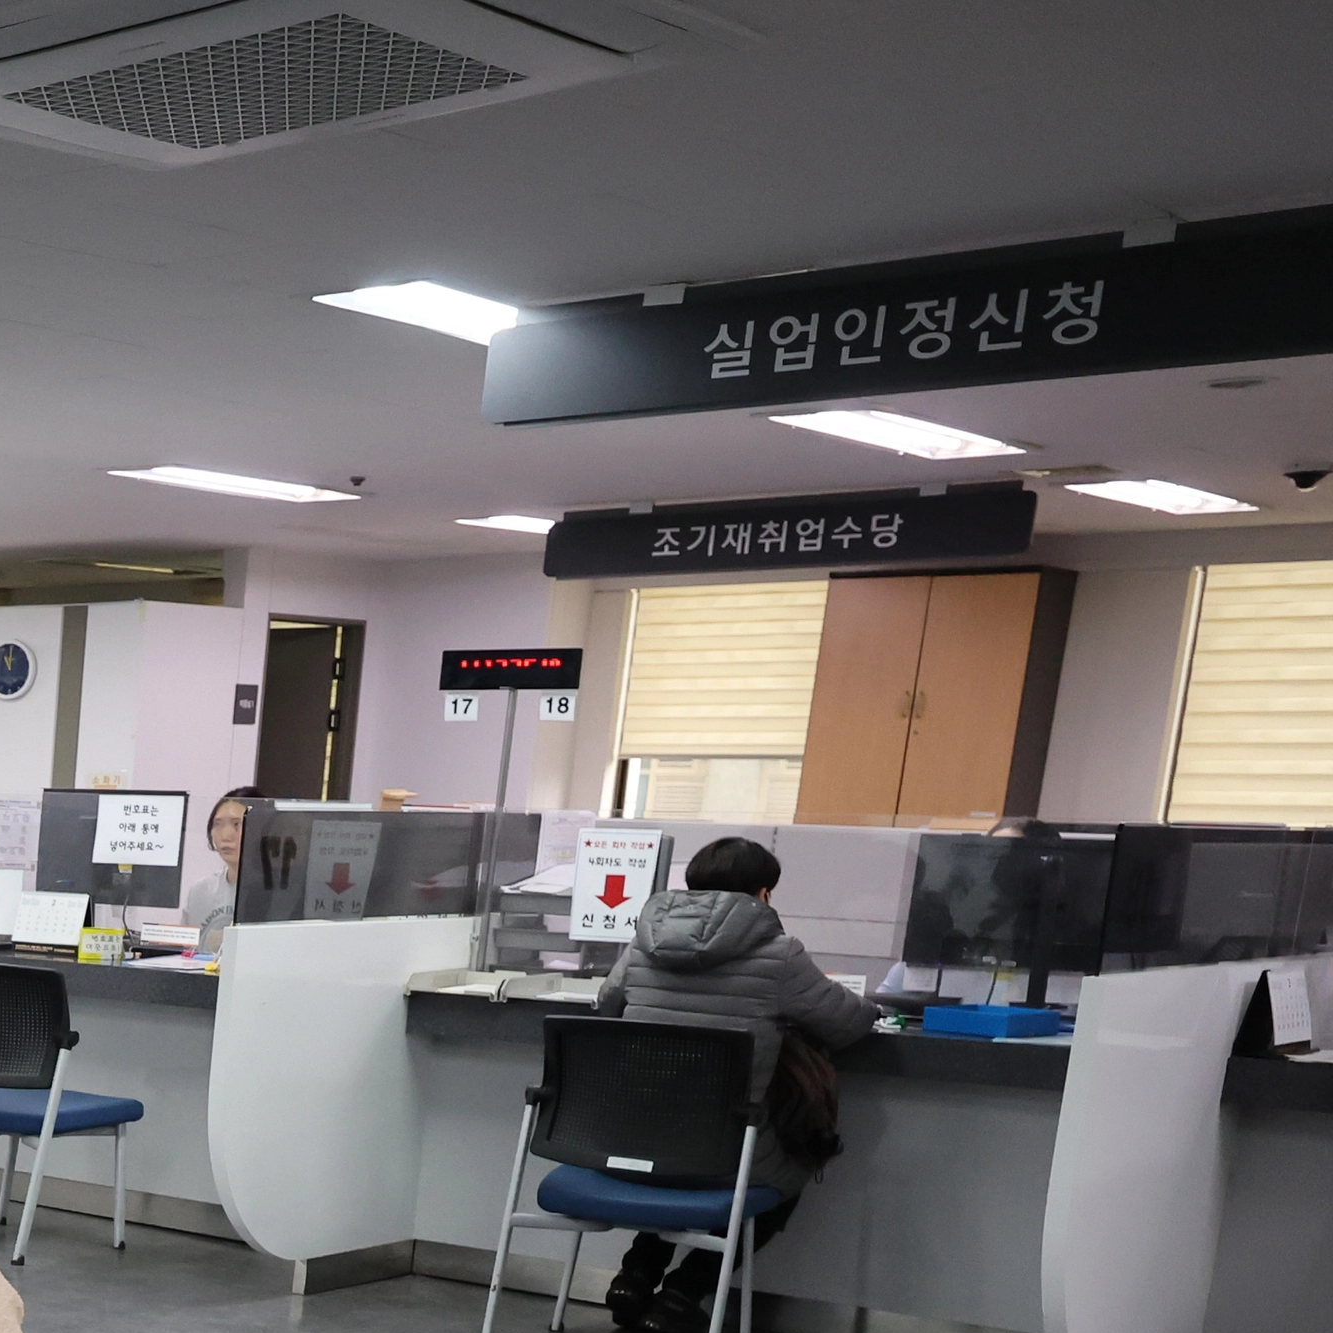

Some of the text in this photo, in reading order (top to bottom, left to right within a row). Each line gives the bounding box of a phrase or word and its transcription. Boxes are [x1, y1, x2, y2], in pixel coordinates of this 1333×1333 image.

[703, 279, 1105, 380] 실업인정신청
[651, 513, 904, 557] 조기재취업수당
[451, 698, 473, 714] 17
[546, 696, 569, 713] 18
[123, 804, 159, 816] 번호표는
[118, 822, 160, 835] 아래 통에
[612, 841, 626, 849] 회차
[588, 857, 647, 868] 4회차도 작성
